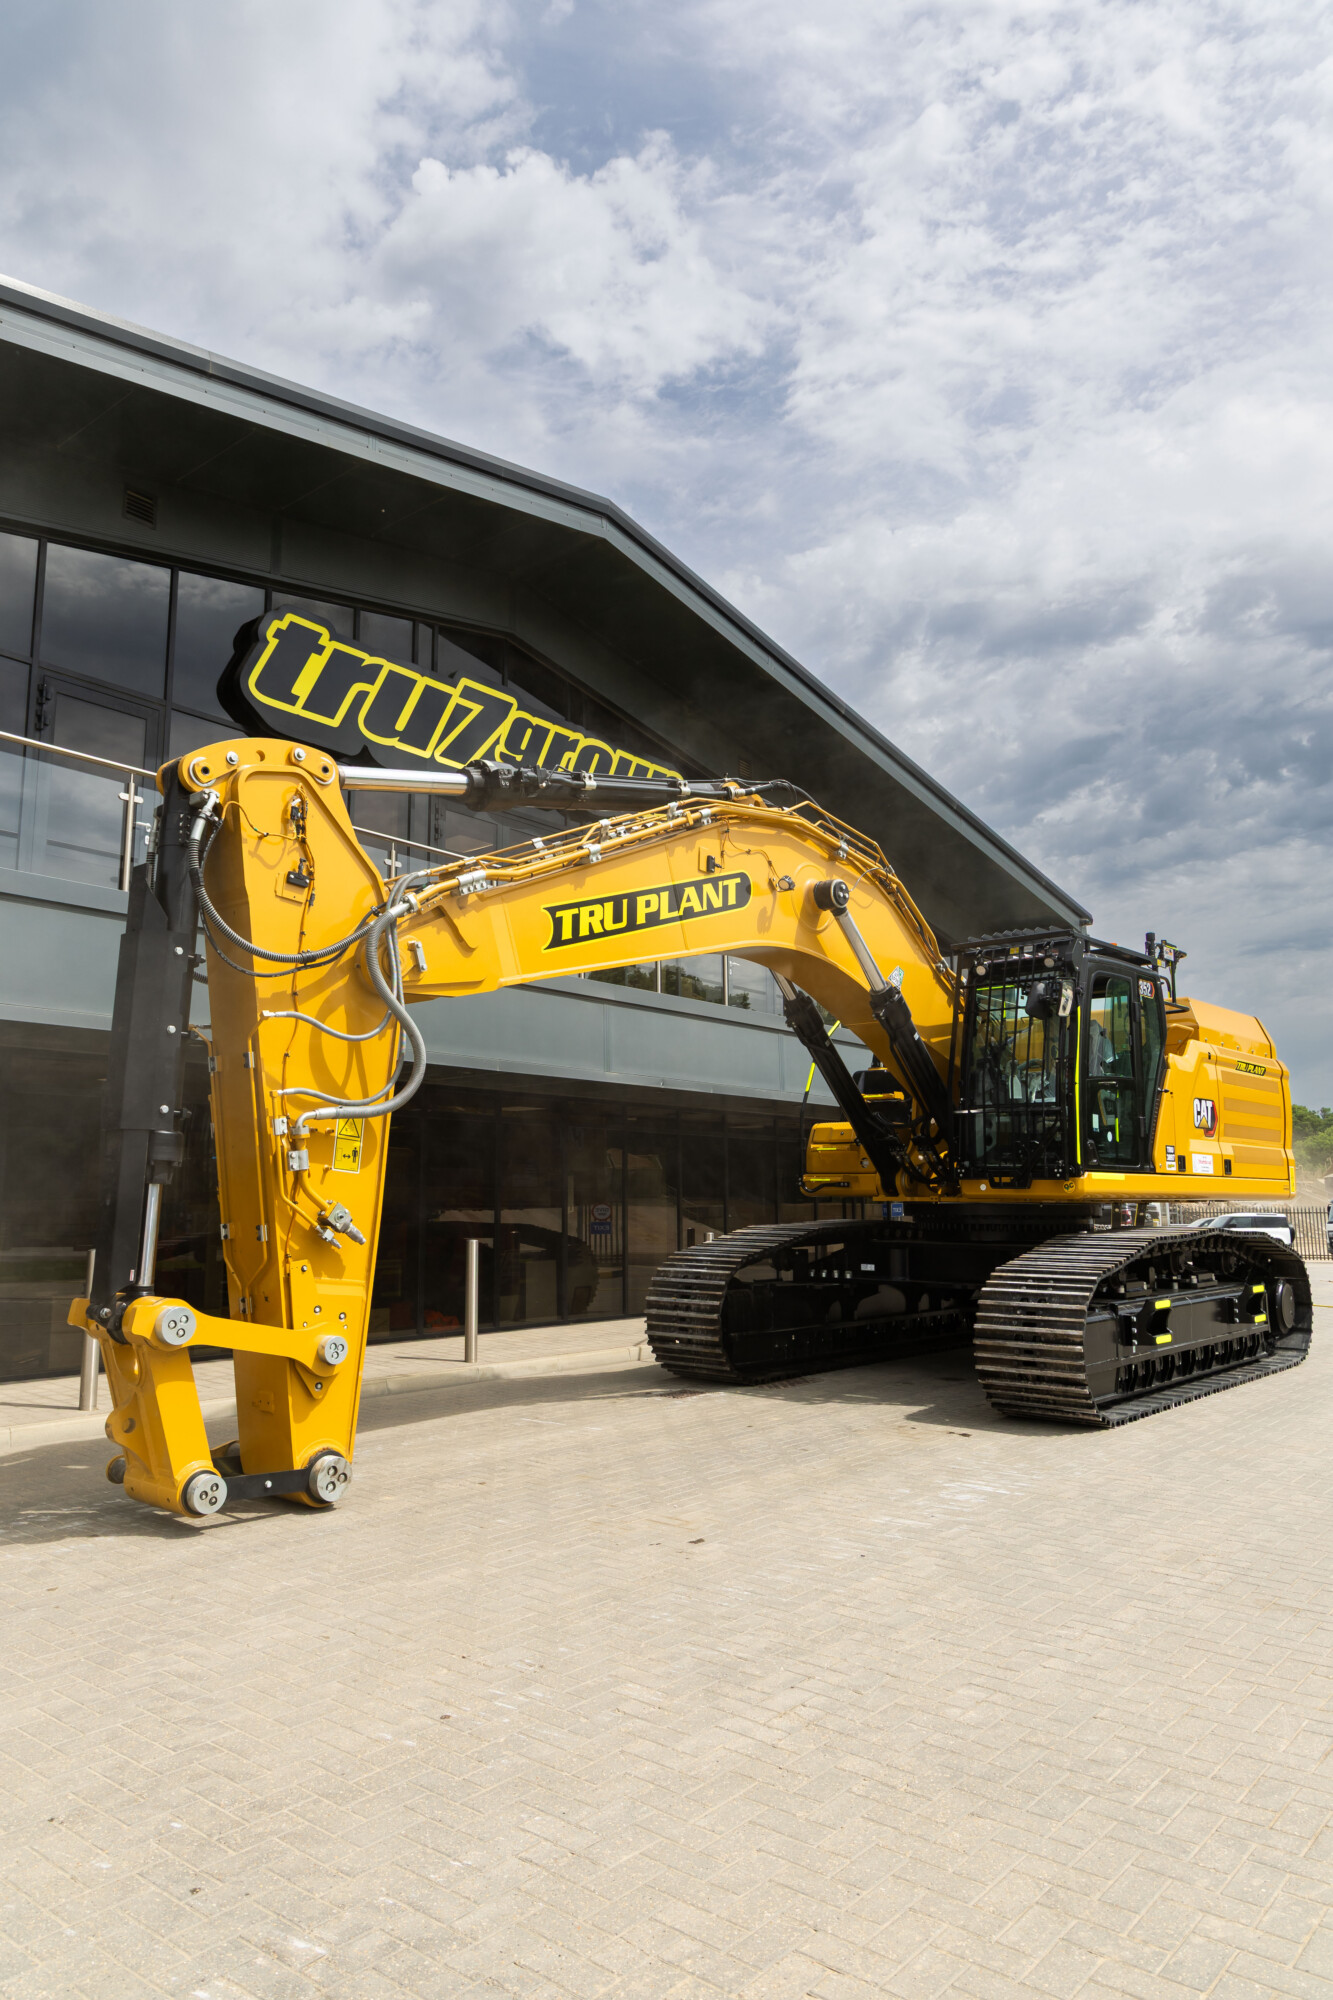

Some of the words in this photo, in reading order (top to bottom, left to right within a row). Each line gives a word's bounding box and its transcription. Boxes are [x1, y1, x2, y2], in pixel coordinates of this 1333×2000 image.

[495, 710, 685, 781] grou
[555, 898, 628, 941] TRU
[636, 877, 741, 925] PLANT
[1139, 980, 1152, 997] 352
[1247, 1064, 1266, 1076] PLANT
[1193, 1098, 1213, 1129] CAT
